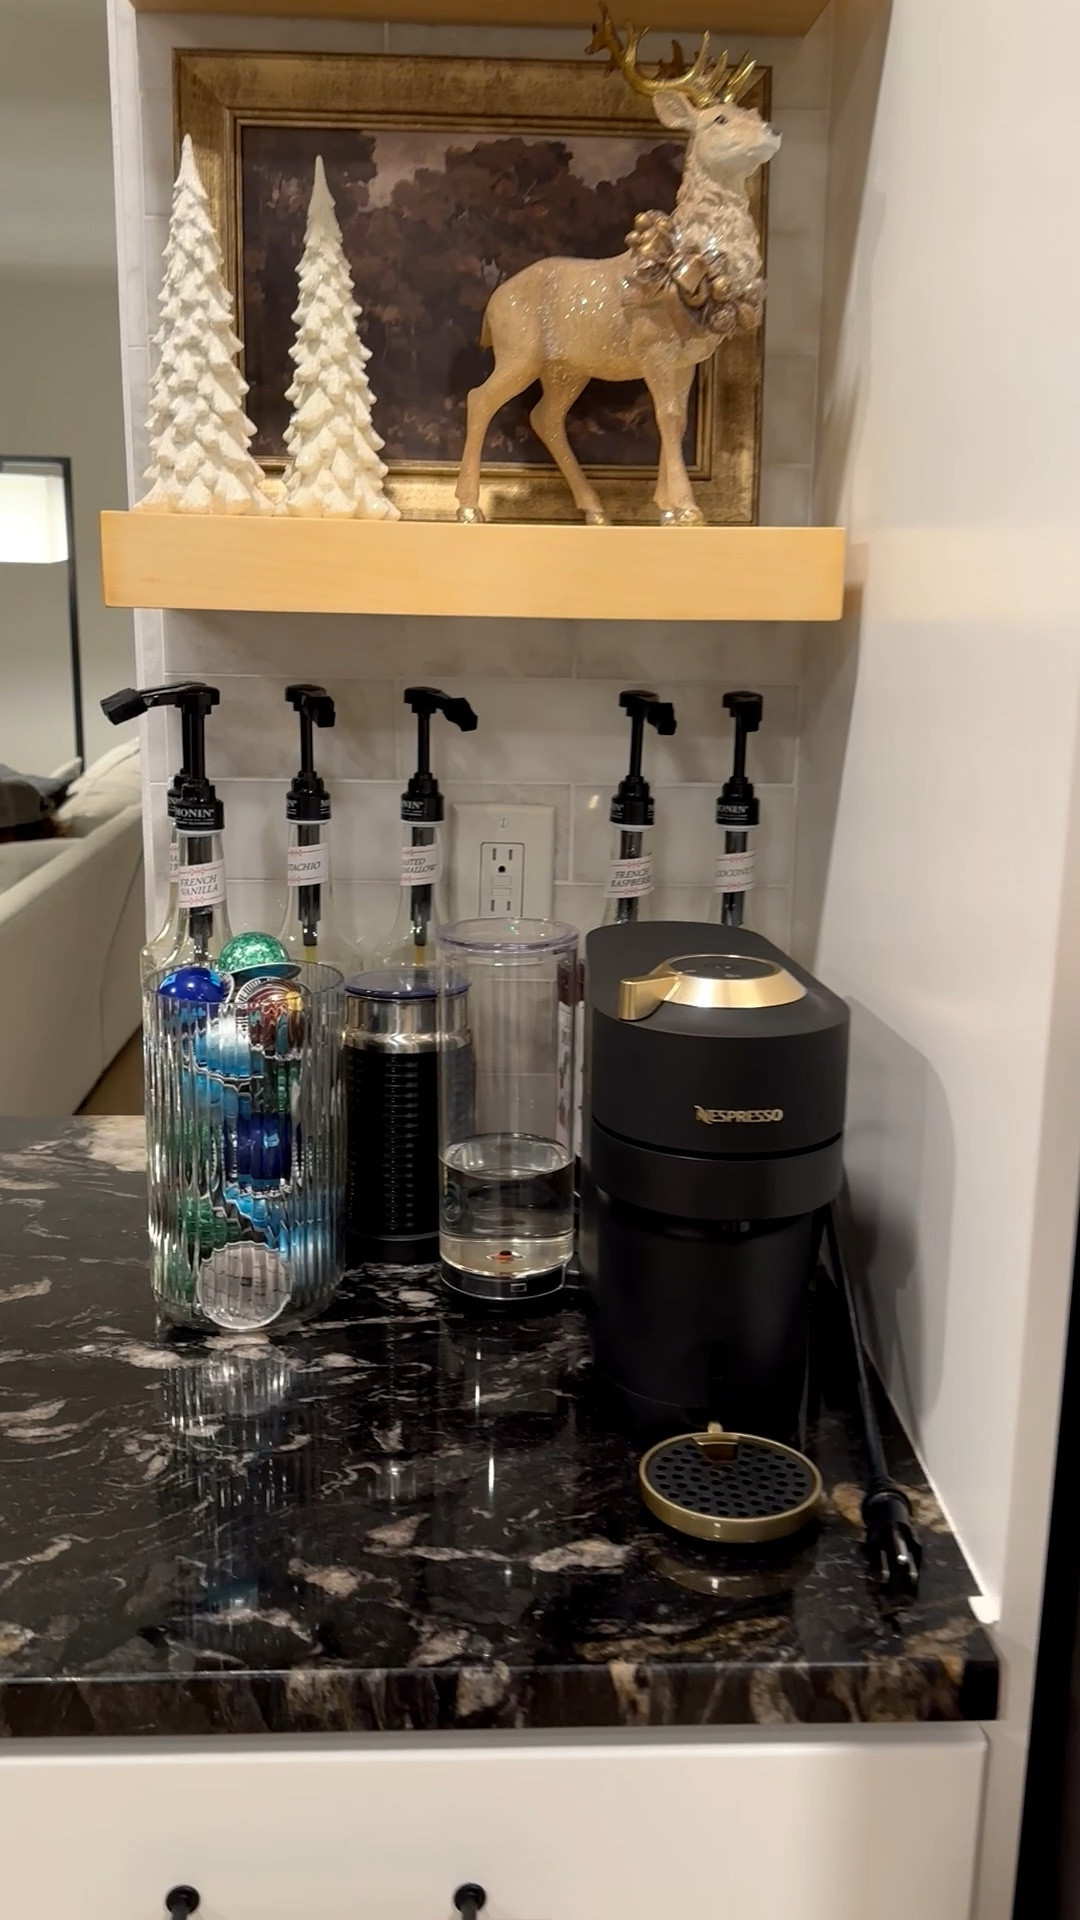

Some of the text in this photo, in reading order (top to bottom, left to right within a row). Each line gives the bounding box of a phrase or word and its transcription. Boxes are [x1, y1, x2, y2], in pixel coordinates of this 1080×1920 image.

[717, 805, 748, 814] ONIN
[180, 874, 217, 887] FRENCH
[180, 884, 219, 897] VANILLA
[694, 1105, 784, 1125] NESPRESSO
